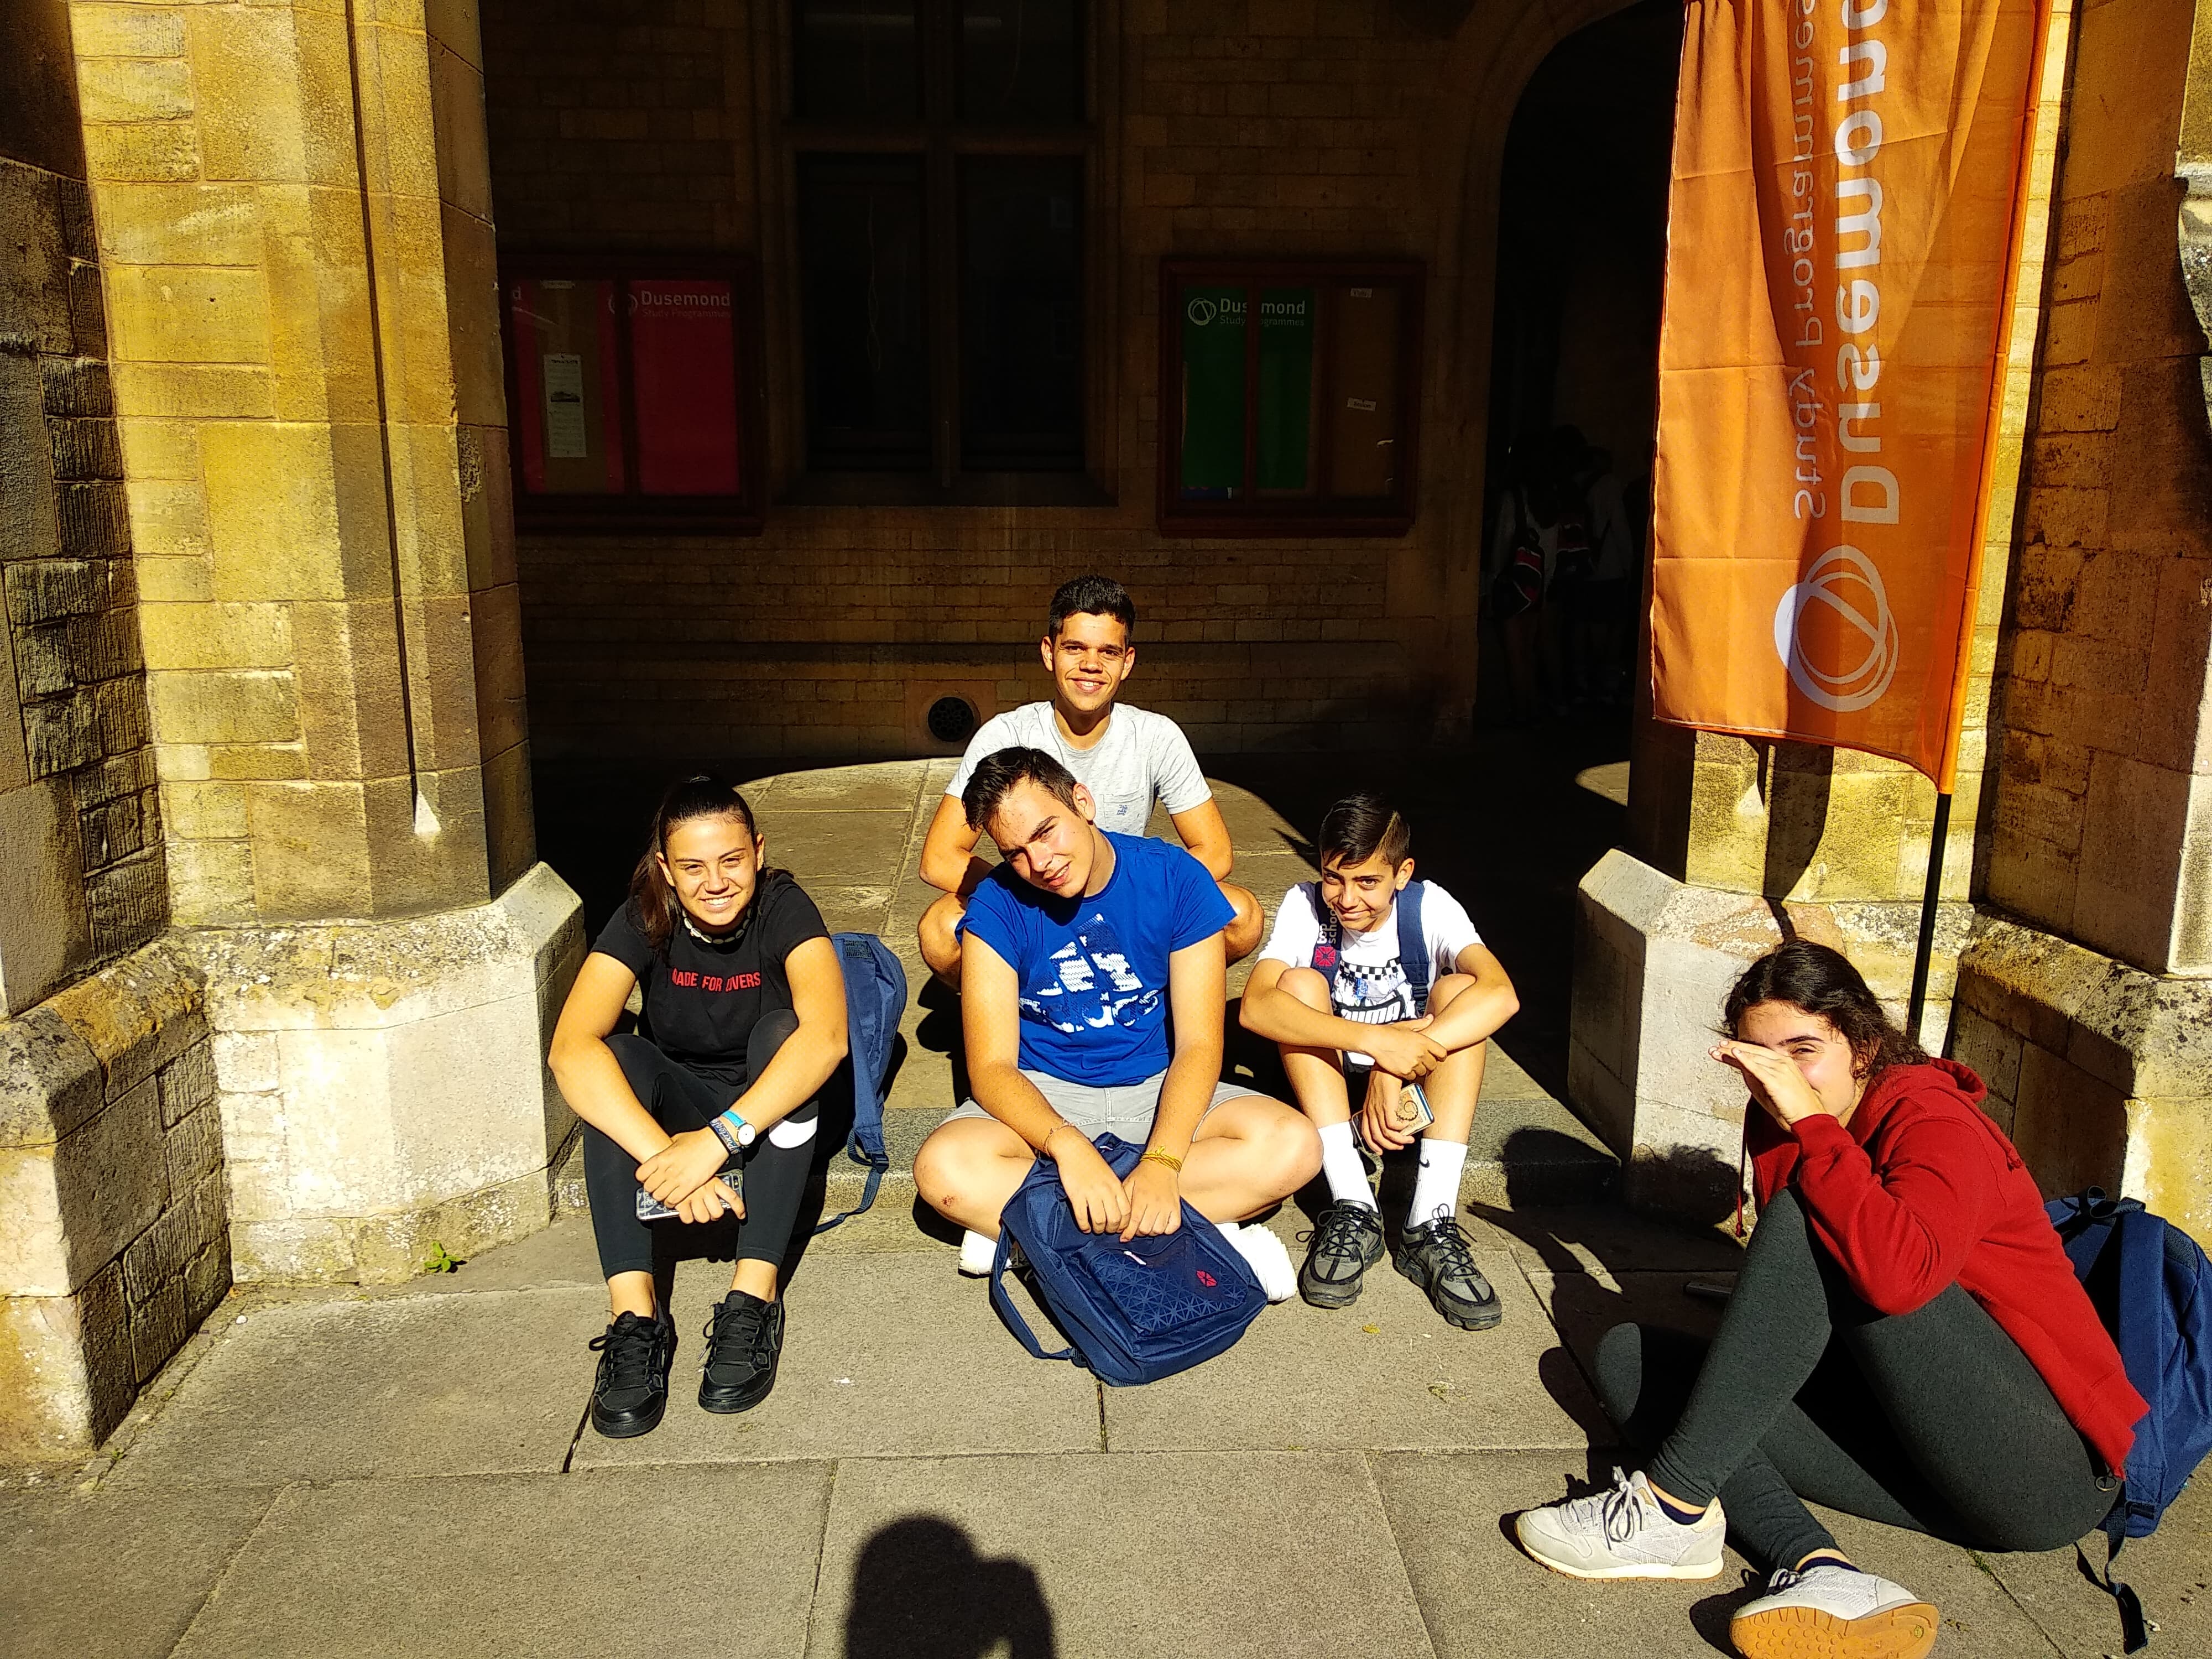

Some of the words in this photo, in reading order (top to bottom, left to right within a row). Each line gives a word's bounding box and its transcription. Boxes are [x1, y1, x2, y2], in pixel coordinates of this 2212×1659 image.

[641, 290, 730, 306] Dusemond
[1220, 297, 1306, 315] Dusmond
[1220, 315, 1248, 326] Study
[1317, 924, 1328, 943] top
[1328, 906, 1338, 945] schoo
[702, 975, 723, 992] FOR
